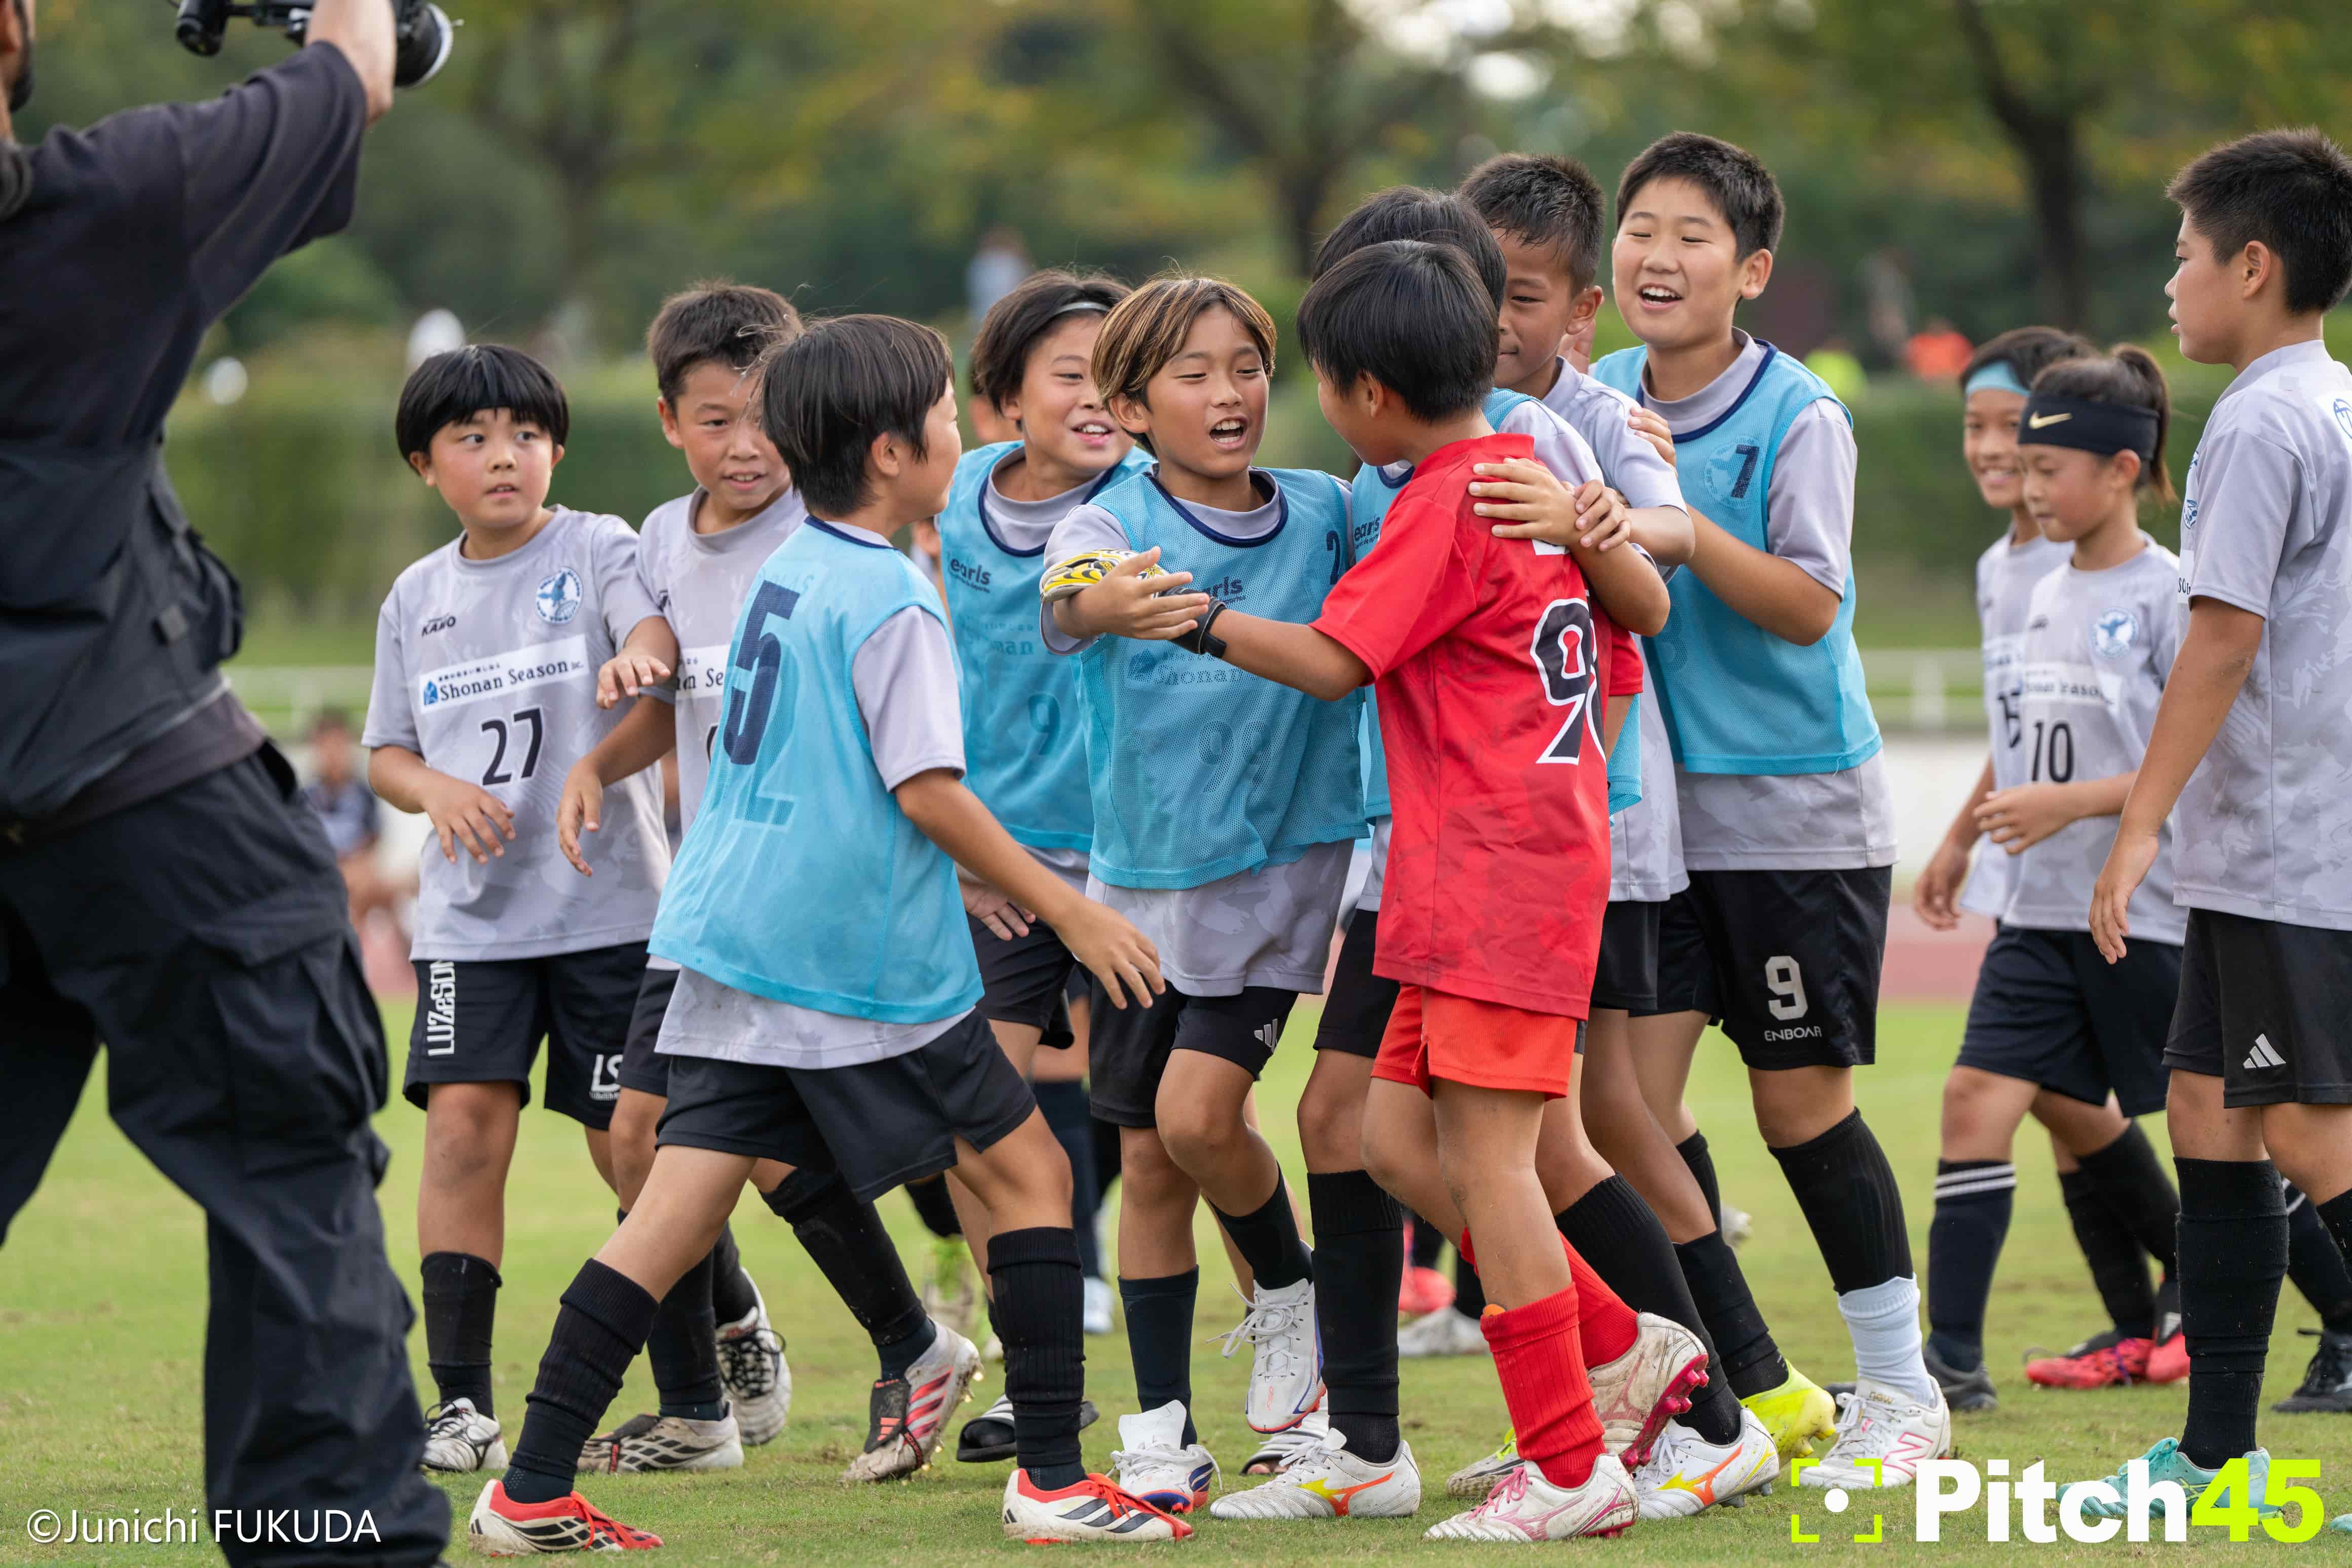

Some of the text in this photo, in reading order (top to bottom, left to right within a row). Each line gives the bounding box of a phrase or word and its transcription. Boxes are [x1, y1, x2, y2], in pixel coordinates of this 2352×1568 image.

[1730, 444, 1760, 499] 7
[951, 558, 992, 585] earls
[1326, 530, 1341, 585] 2
[439, 676, 503, 701] Shonan
[508, 660, 569, 685] Season
[723, 580, 801, 766] 5
[481, 708, 544, 786] 27
[2031, 722, 2074, 783] 10
[1765, 955, 1808, 1020] 9
